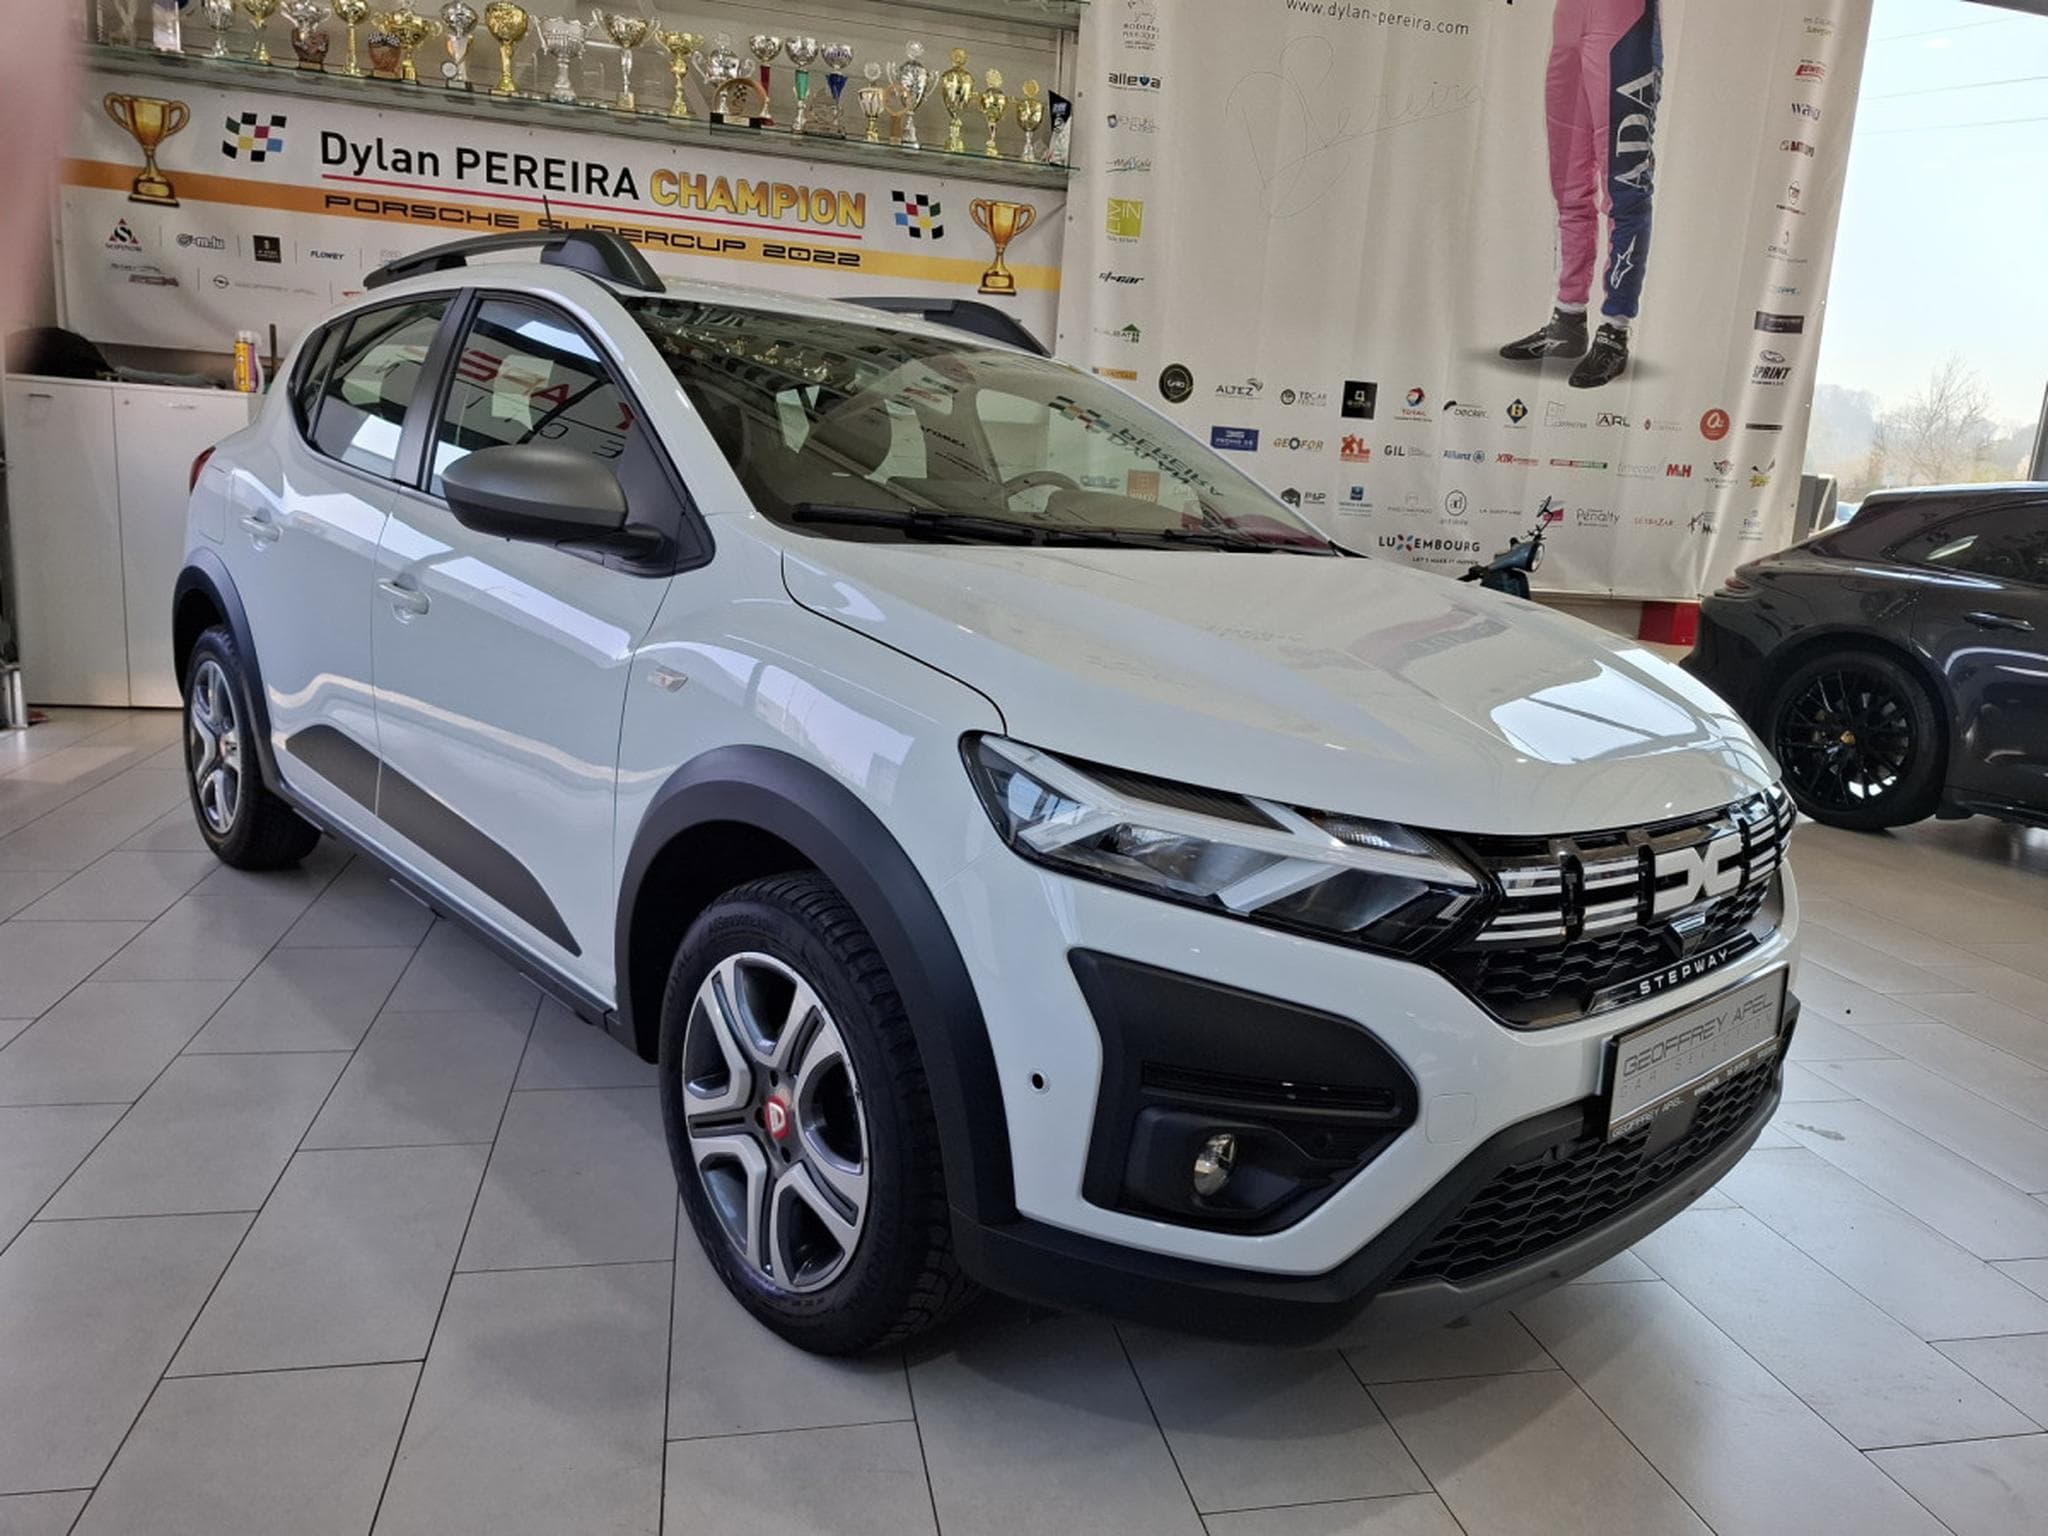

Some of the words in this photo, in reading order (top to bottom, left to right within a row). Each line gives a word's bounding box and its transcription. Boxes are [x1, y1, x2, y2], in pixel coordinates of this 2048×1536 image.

[1285, 0, 1470, 36] www.dylan-pereira.com
[319, 130, 440, 177] Dylan
[455, 147, 640, 201] PEREIRA
[649, 169, 867, 230] CHAMPION
[324, 194, 520, 229] PORSCHE
[762, 243, 861, 268] 2022
[1378, 533, 1481, 553] LUXEMBOURG
[1638, 949, 1730, 996] STEPWAY
[1623, 1012, 1729, 1078] GEOFFREY
